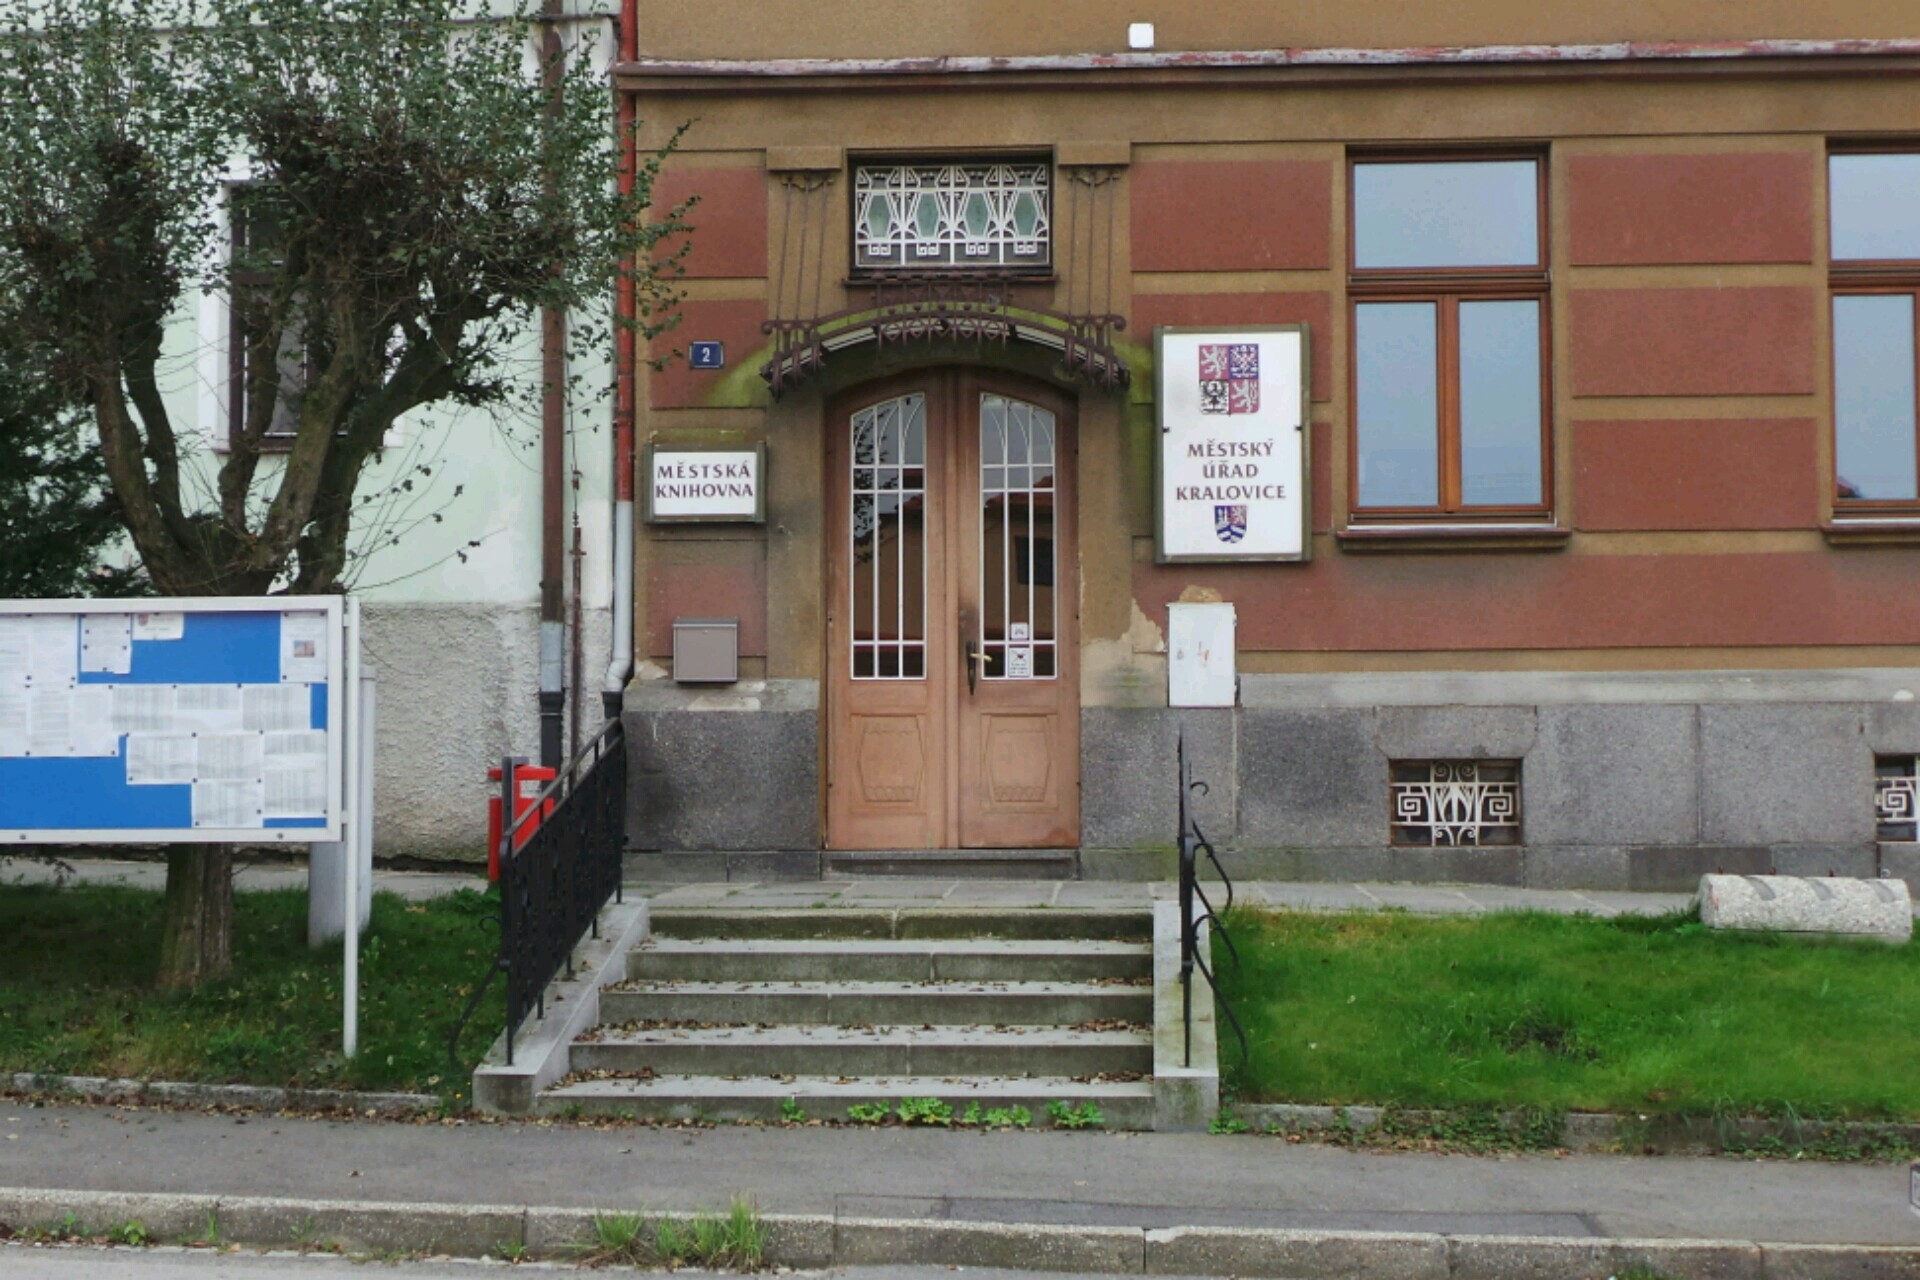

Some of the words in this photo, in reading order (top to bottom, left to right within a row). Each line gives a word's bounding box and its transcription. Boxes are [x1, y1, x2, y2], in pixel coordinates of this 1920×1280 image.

[702, 347, 710, 362] 2
[1187, 438, 1274, 457] MĚSTSKÝ
[657, 460, 751, 478] MĚSTSKÁ
[1203, 460, 1259, 479] ÚŘAD
[655, 483, 754, 499] KNIHOVNA
[1176, 485, 1286, 501] KRALOVICE
